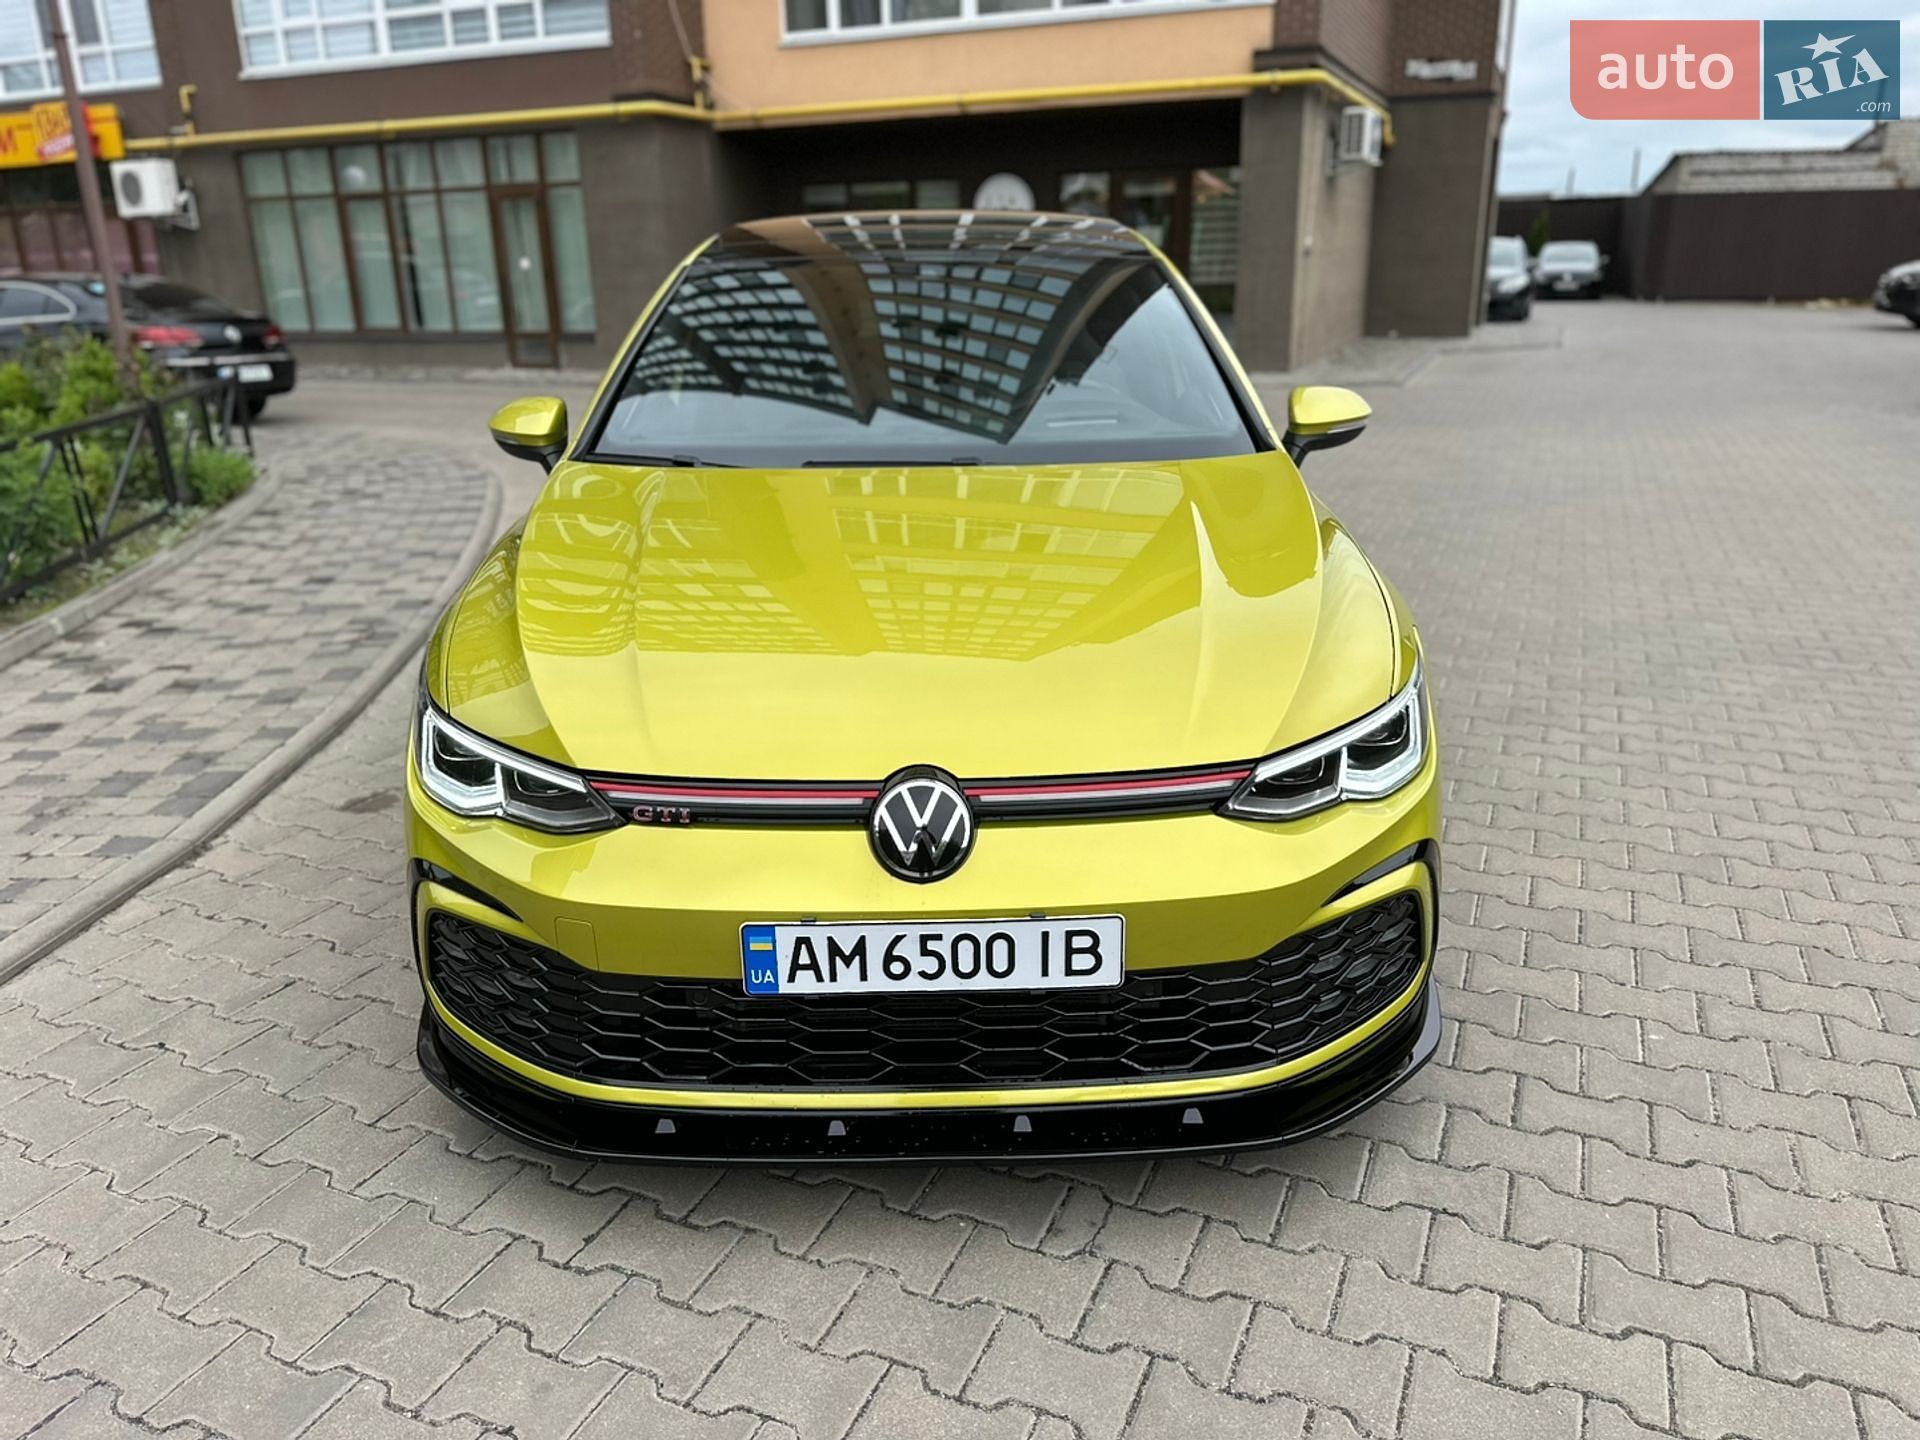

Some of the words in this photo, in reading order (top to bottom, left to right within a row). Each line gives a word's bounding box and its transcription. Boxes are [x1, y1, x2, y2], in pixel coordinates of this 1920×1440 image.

[633, 804, 690, 823] GTI
[786, 934, 868, 984] AM
[882, 932, 1016, 981] 6500
[1040, 929, 1103, 978] IB
[751, 969, 775, 984] UA
